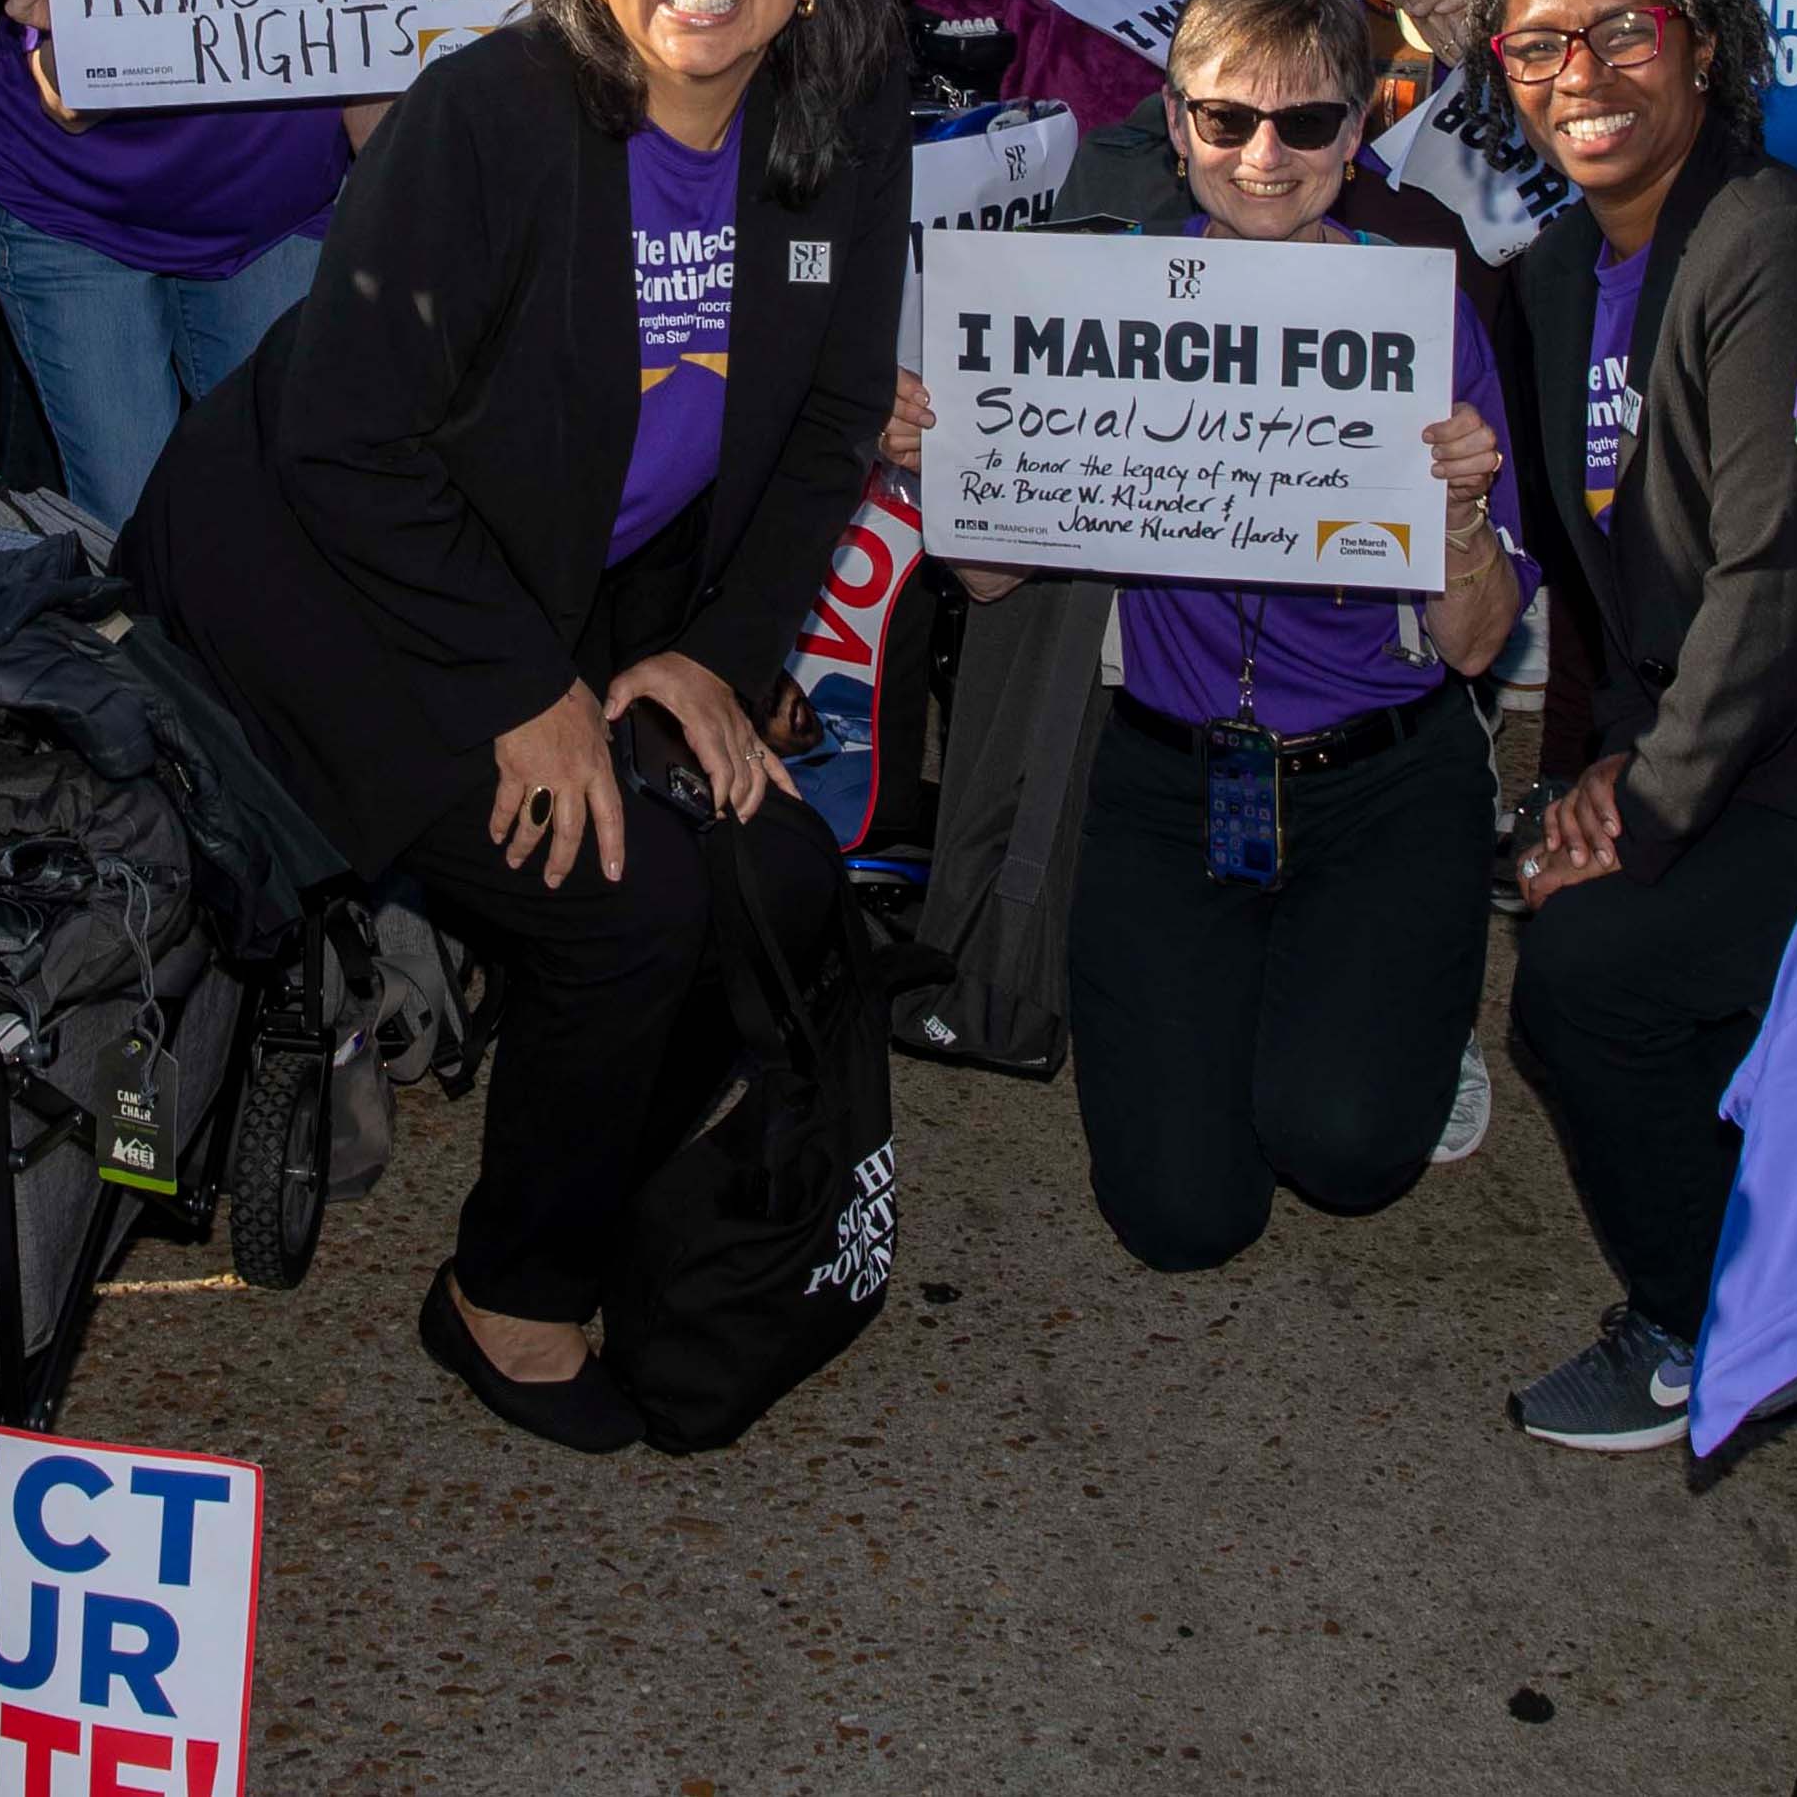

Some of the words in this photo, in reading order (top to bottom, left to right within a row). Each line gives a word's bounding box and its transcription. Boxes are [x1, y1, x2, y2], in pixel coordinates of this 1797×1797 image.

[191, 4, 420, 85] RIGHTS
[957, 312, 992, 372] I
[1012, 314, 1258, 385] MARCH
[1279, 329, 1416, 394] FOR
[974, 387, 1137, 439] Social
[1142, 398, 1382, 448] Justice
[961, 471, 1008, 501] Rev.
[1015, 470, 1072, 506] Bruce
[1111, 483, 1217, 514] Klunder
[976, 449, 1003, 471] to
[1017, 450, 1070, 476] honor
[1080, 452, 1112, 480] the
[1121, 455, 1190, 492] legacy
[1196, 461, 1226, 488] of
[1230, 468, 1265, 492] my
[1270, 466, 1350, 495] parents
[1056, 513, 1134, 535] Joanne
[1139, 515, 1227, 543] Klunder
[1230, 519, 1301, 554] Hardy
[1340, 537, 1358, 547] The
[1358, 537, 1387, 548] March
[1340, 546, 1387, 557] Continues
